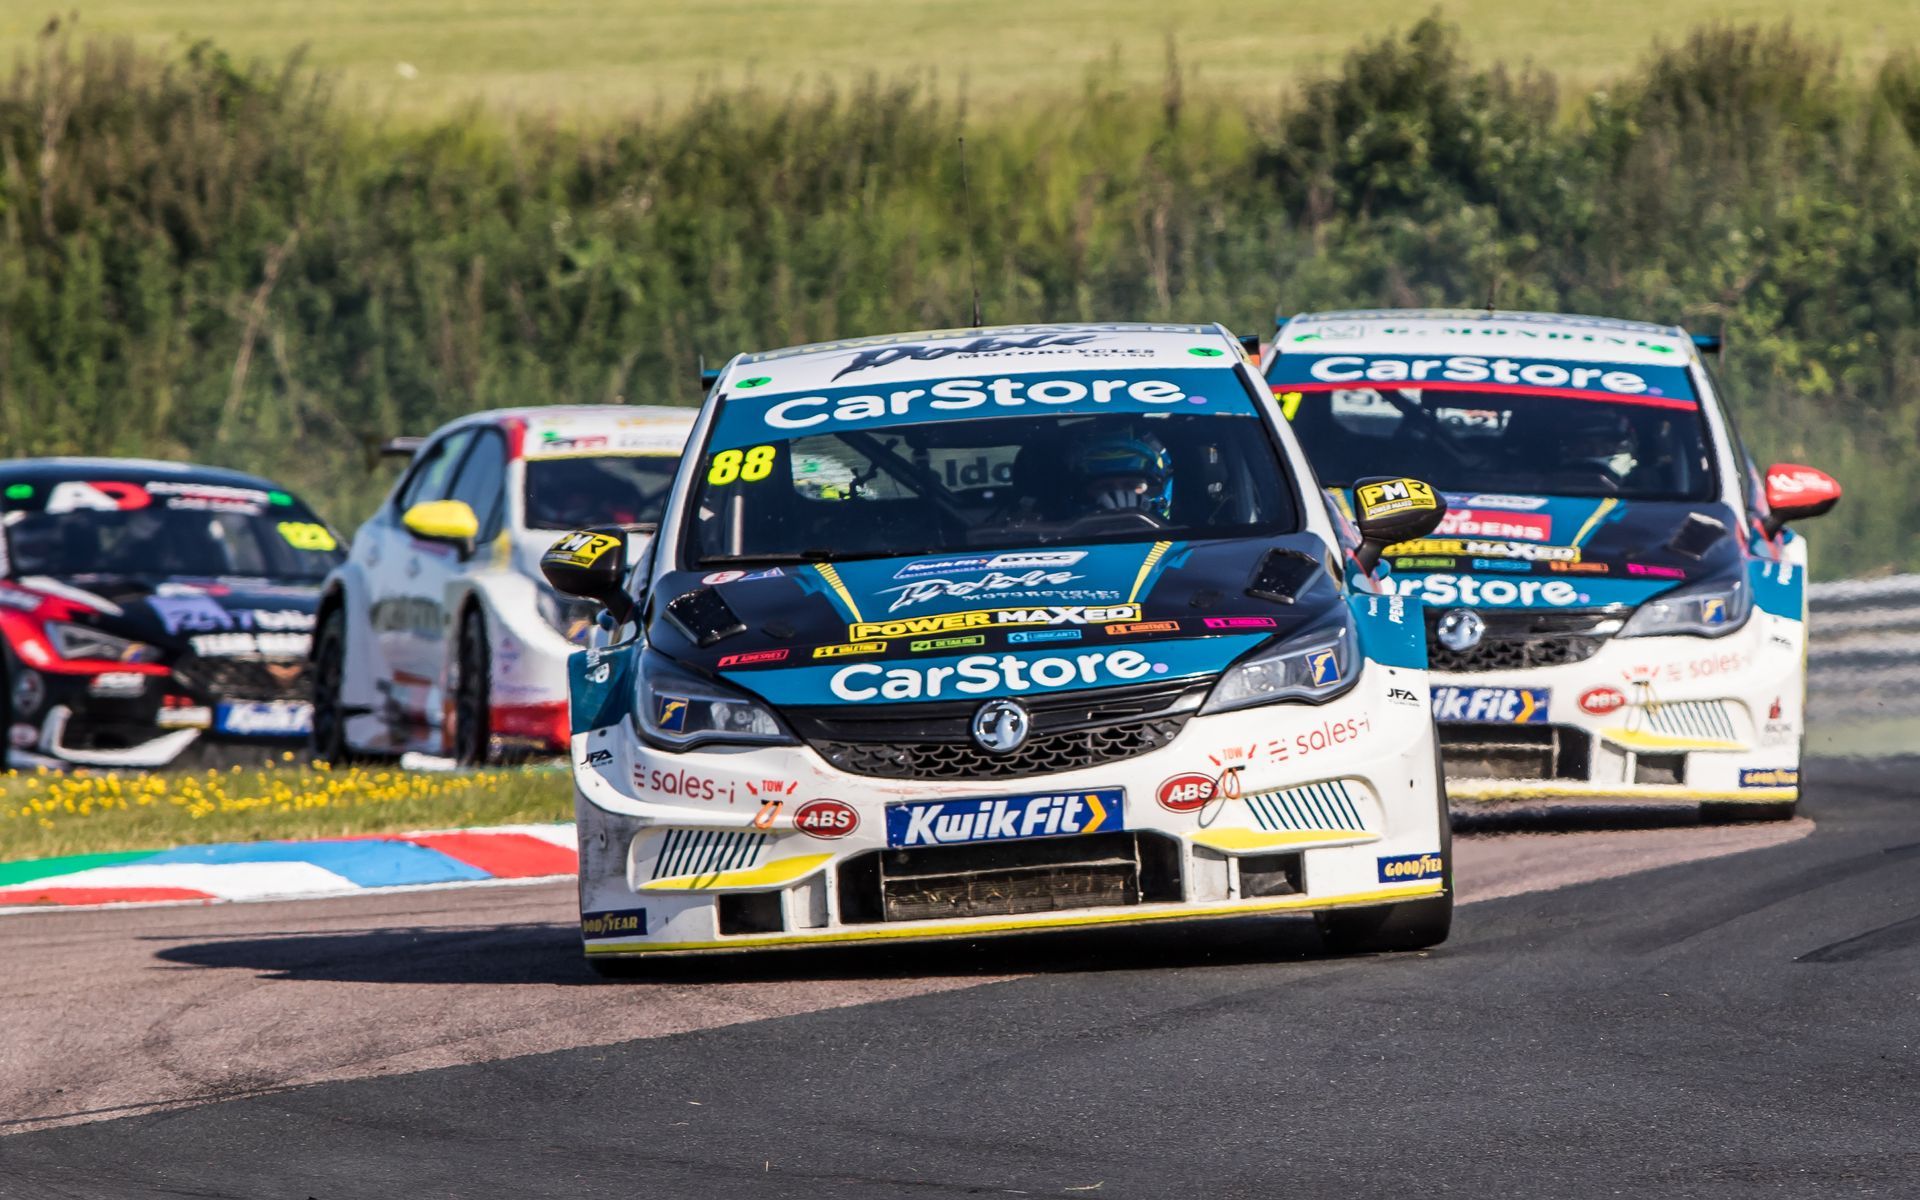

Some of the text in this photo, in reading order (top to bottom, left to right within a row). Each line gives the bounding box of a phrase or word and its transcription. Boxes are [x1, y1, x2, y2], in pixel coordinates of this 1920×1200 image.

[707, 445, 776, 486] 88
[1361, 480, 1426, 506] PMR
[1381, 541, 1575, 560] WER MAXED
[857, 606, 1134, 637] POWER MAXED
[1387, 688, 1418, 701] JFA
[1296, 712, 1371, 755] sales-i
[580, 749, 614, 765] JFA
[1223, 746, 1244, 760] TOW
[651, 769, 736, 804] sales-i
[762, 780, 785, 793] TOW
[1166, 781, 1214, 803] ABS
[803, 810, 851, 829] ABS
